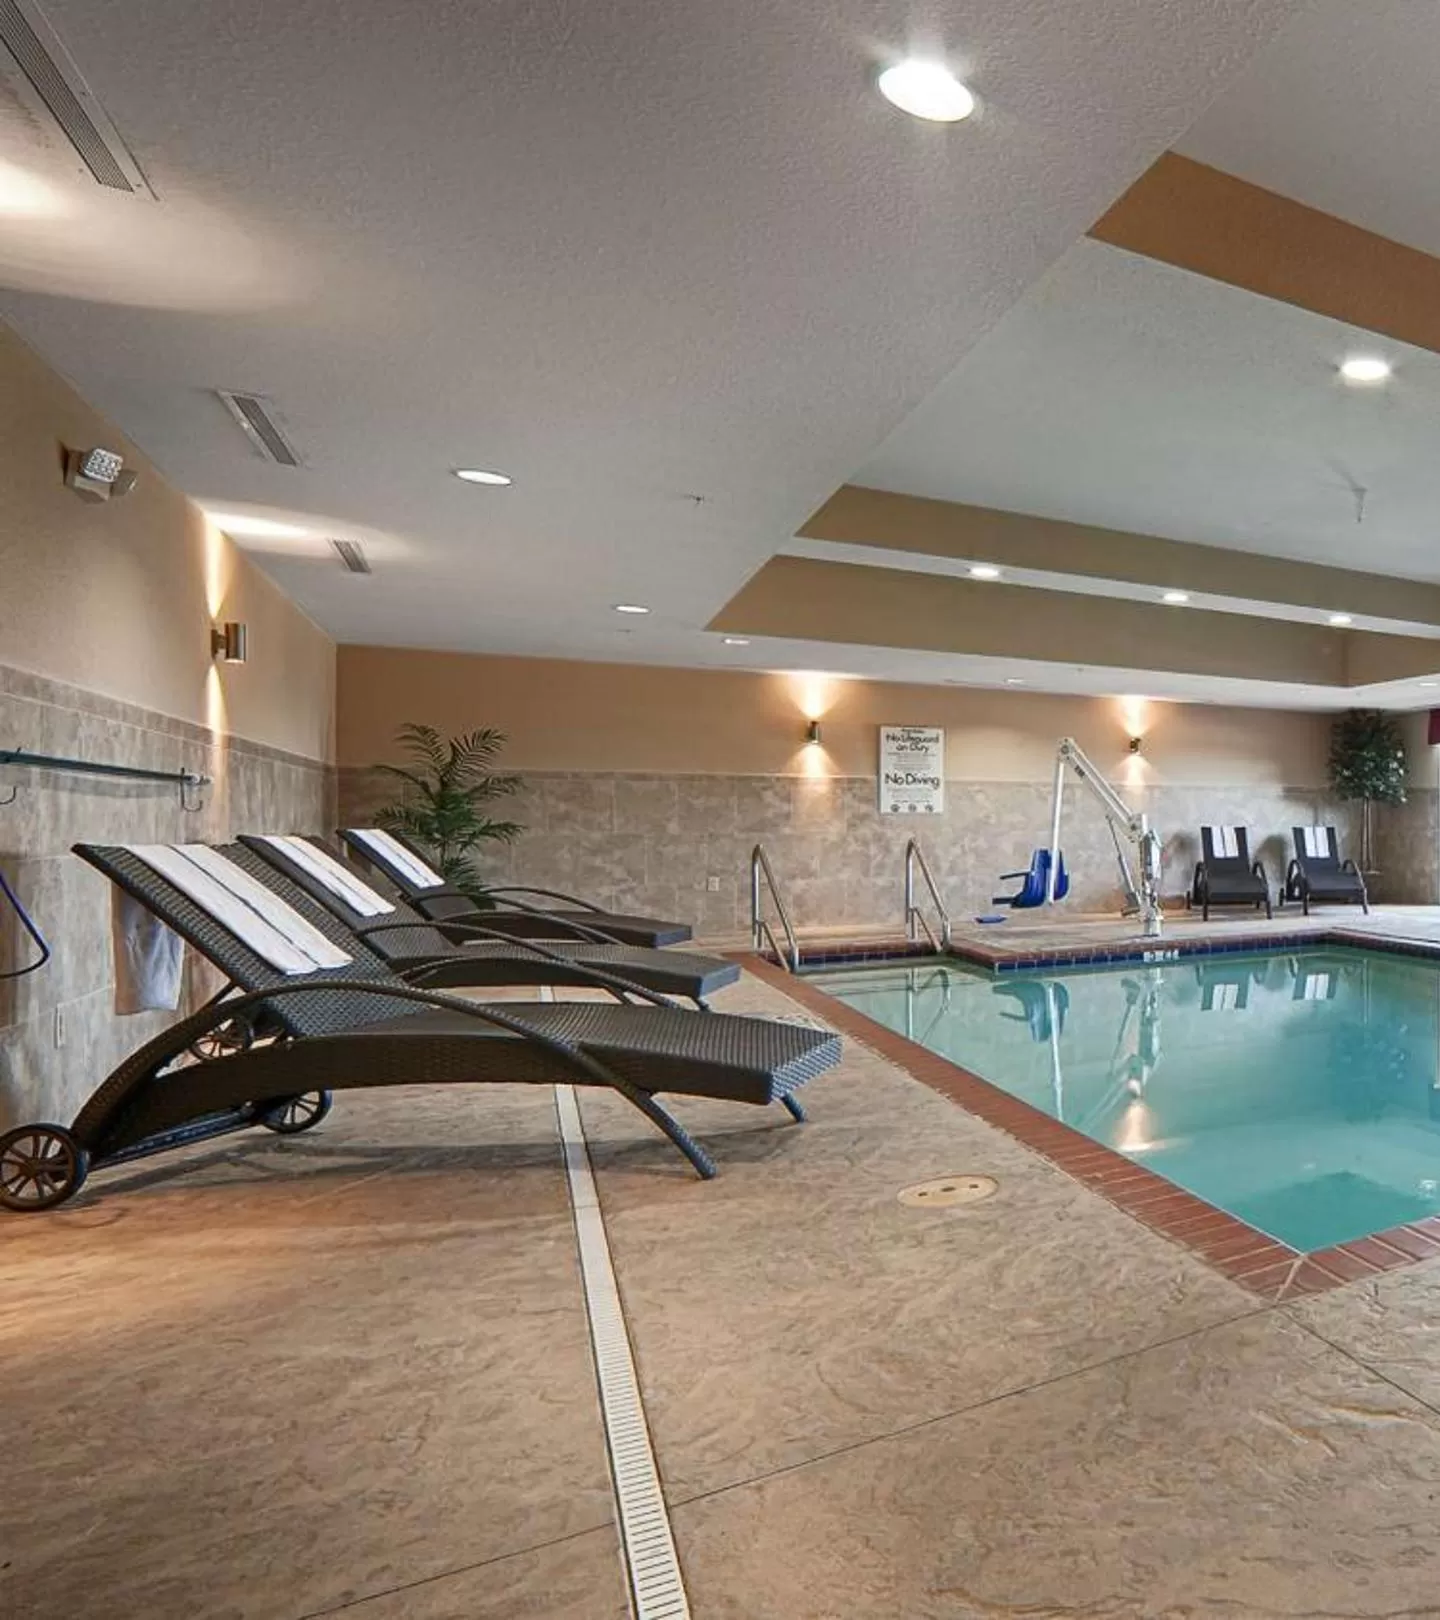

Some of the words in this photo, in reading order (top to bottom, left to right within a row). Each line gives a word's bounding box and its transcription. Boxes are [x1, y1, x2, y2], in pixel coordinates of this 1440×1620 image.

[886, 734, 900, 743] No
[901, 732, 939, 745] Lifeguard
[885, 773, 904, 786] No
[905, 773, 940, 790] Diving
